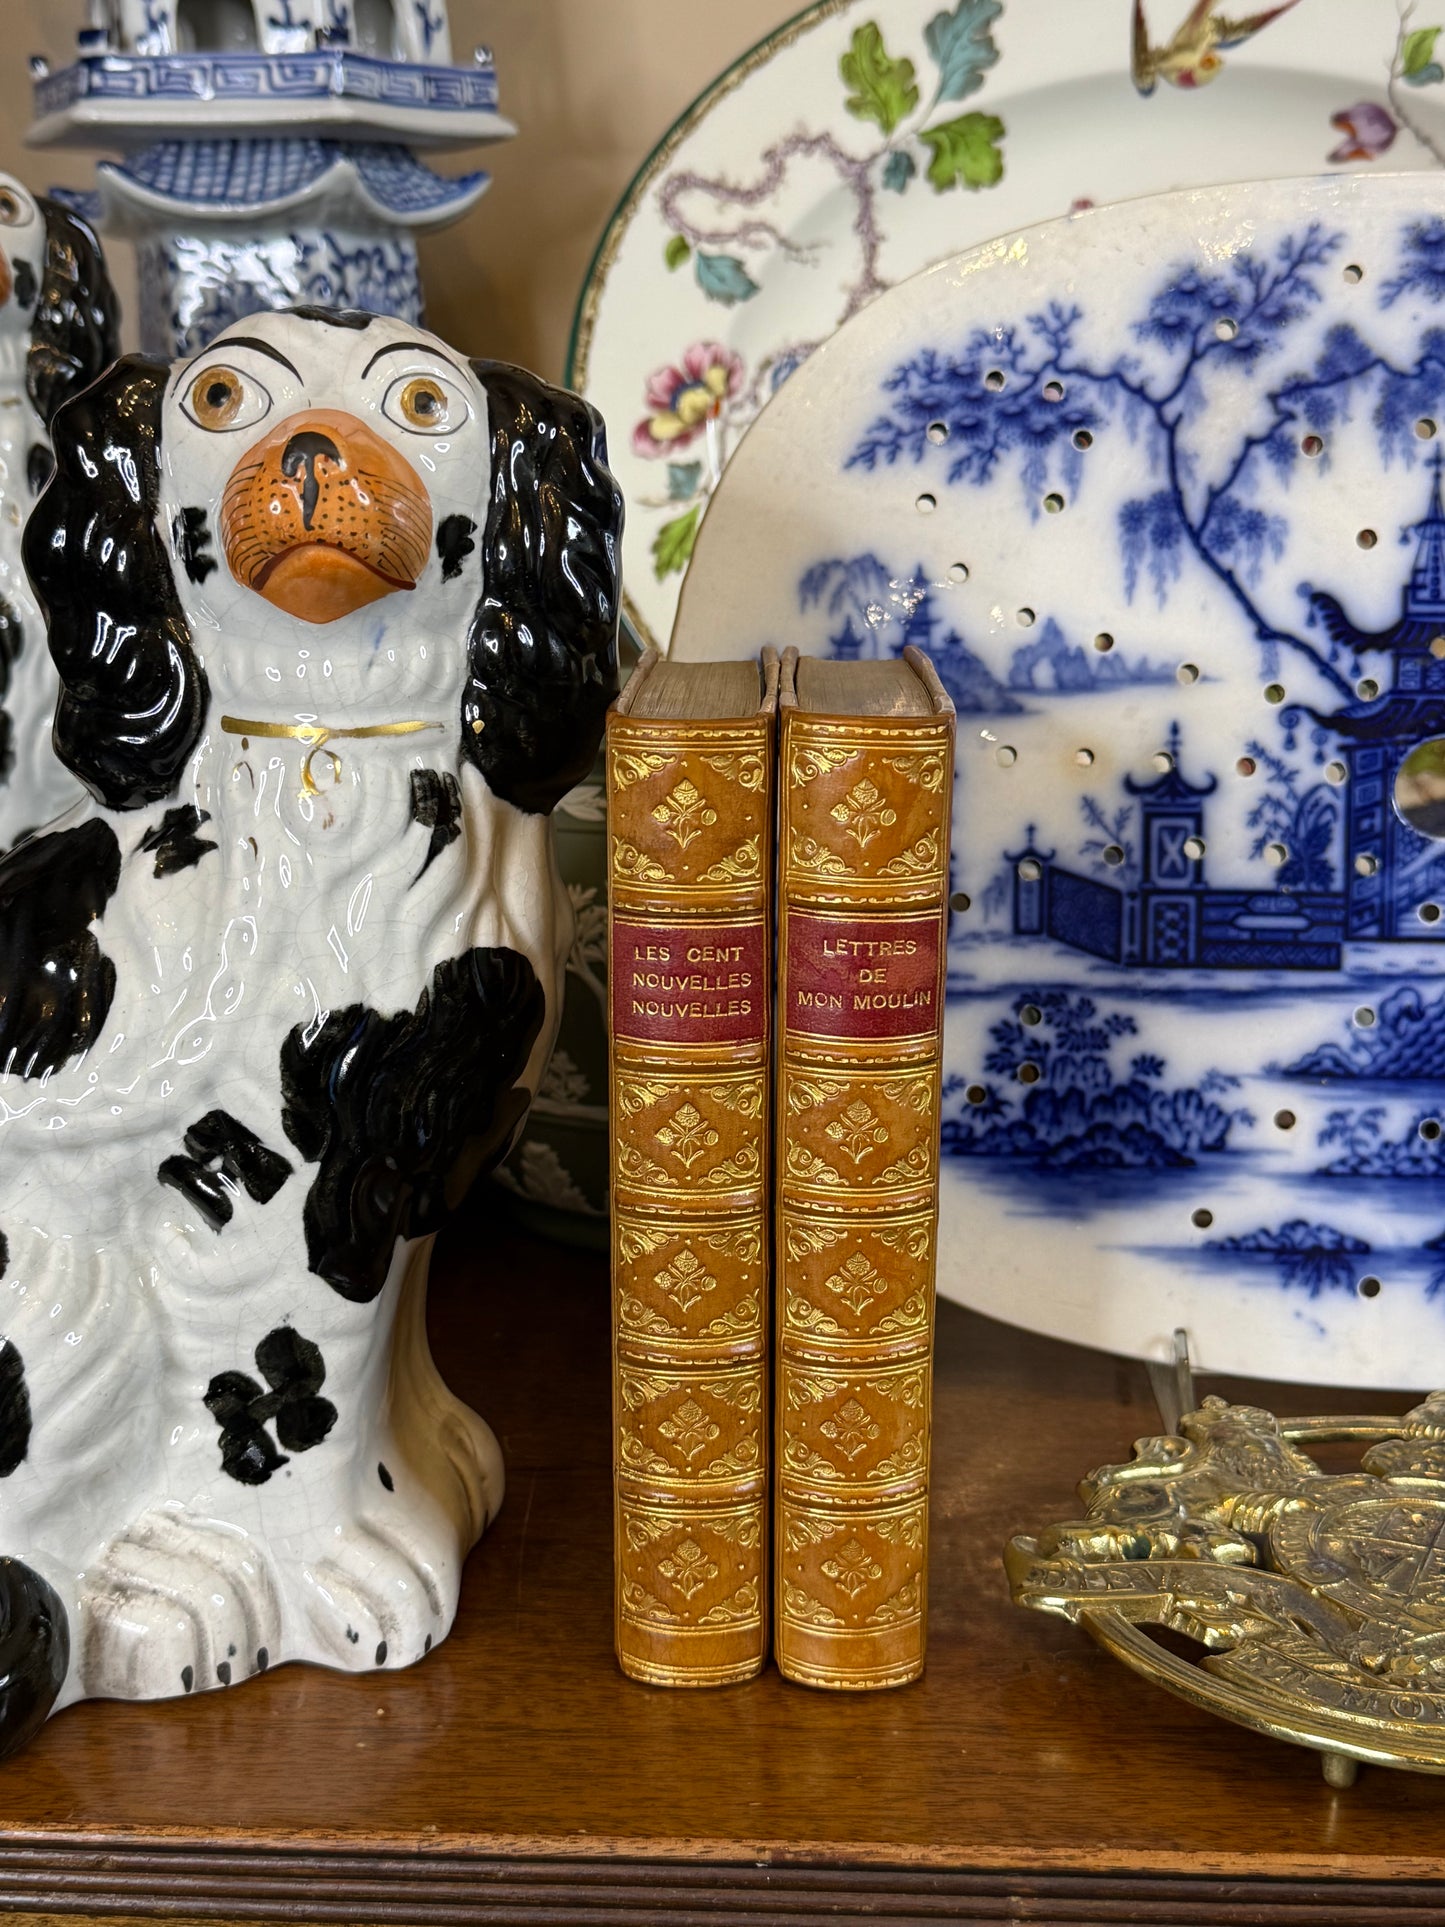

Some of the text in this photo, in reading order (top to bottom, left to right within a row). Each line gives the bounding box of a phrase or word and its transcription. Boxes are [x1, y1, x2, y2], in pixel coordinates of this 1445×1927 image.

[633, 945, 745, 963] LES CENT
[822, 939, 918, 957] LETTRES
[632, 972, 752, 991] NOUVELLES
[858, 968, 888, 984] DE
[631, 1000, 752, 1018] NOUVELLES
[797, 989, 931, 1011] MON MOULIN
